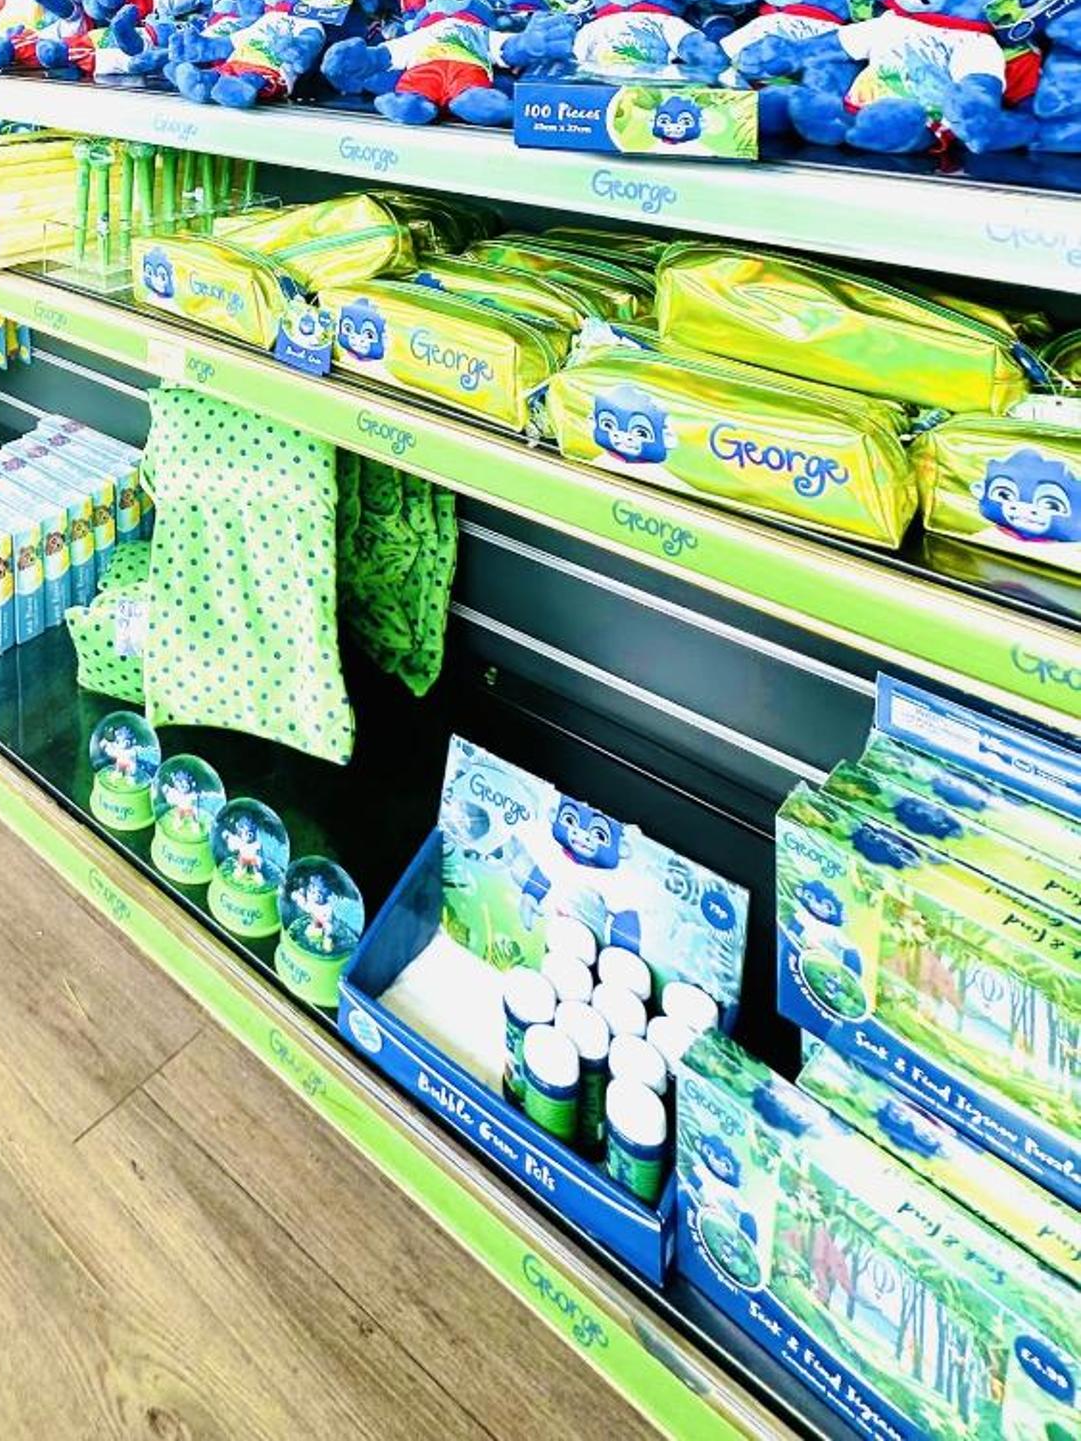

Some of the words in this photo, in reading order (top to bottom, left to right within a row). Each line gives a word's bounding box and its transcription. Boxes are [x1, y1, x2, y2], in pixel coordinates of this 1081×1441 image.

[153, 112, 199, 141] George
[524, 104, 552, 119] 100
[558, 102, 602, 121] Pieces
[338, 136, 399, 171] George
[591, 168, 678, 213] George
[188, 270, 244, 313] George
[186, 355, 216, 382] orge
[409, 326, 494, 392] George
[356, 408, 417, 455] George
[708, 420, 849, 498] George
[611, 498, 698, 556] George
[1010, 644, 1081, 691] Geo
[468, 772, 531, 825] George
[783, 830, 846, 880] George
[220, 892, 263, 926] George
[683, 1078, 748, 1139] George
[855, 1031, 889, 1061] Seek
[894, 1057, 908, 1073] &
[911, 1067, 952, 1103] Find
[954, 1095, 1018, 1143] Jigsaw
[417, 1073, 476, 1127] Bubble
[523, 1156, 557, 1193] Pots
[521, 1252, 609, 1349] George
[748, 1299, 783, 1337] Seek
[786, 1335, 800, 1353] &
[803, 1347, 842, 1390] Find
